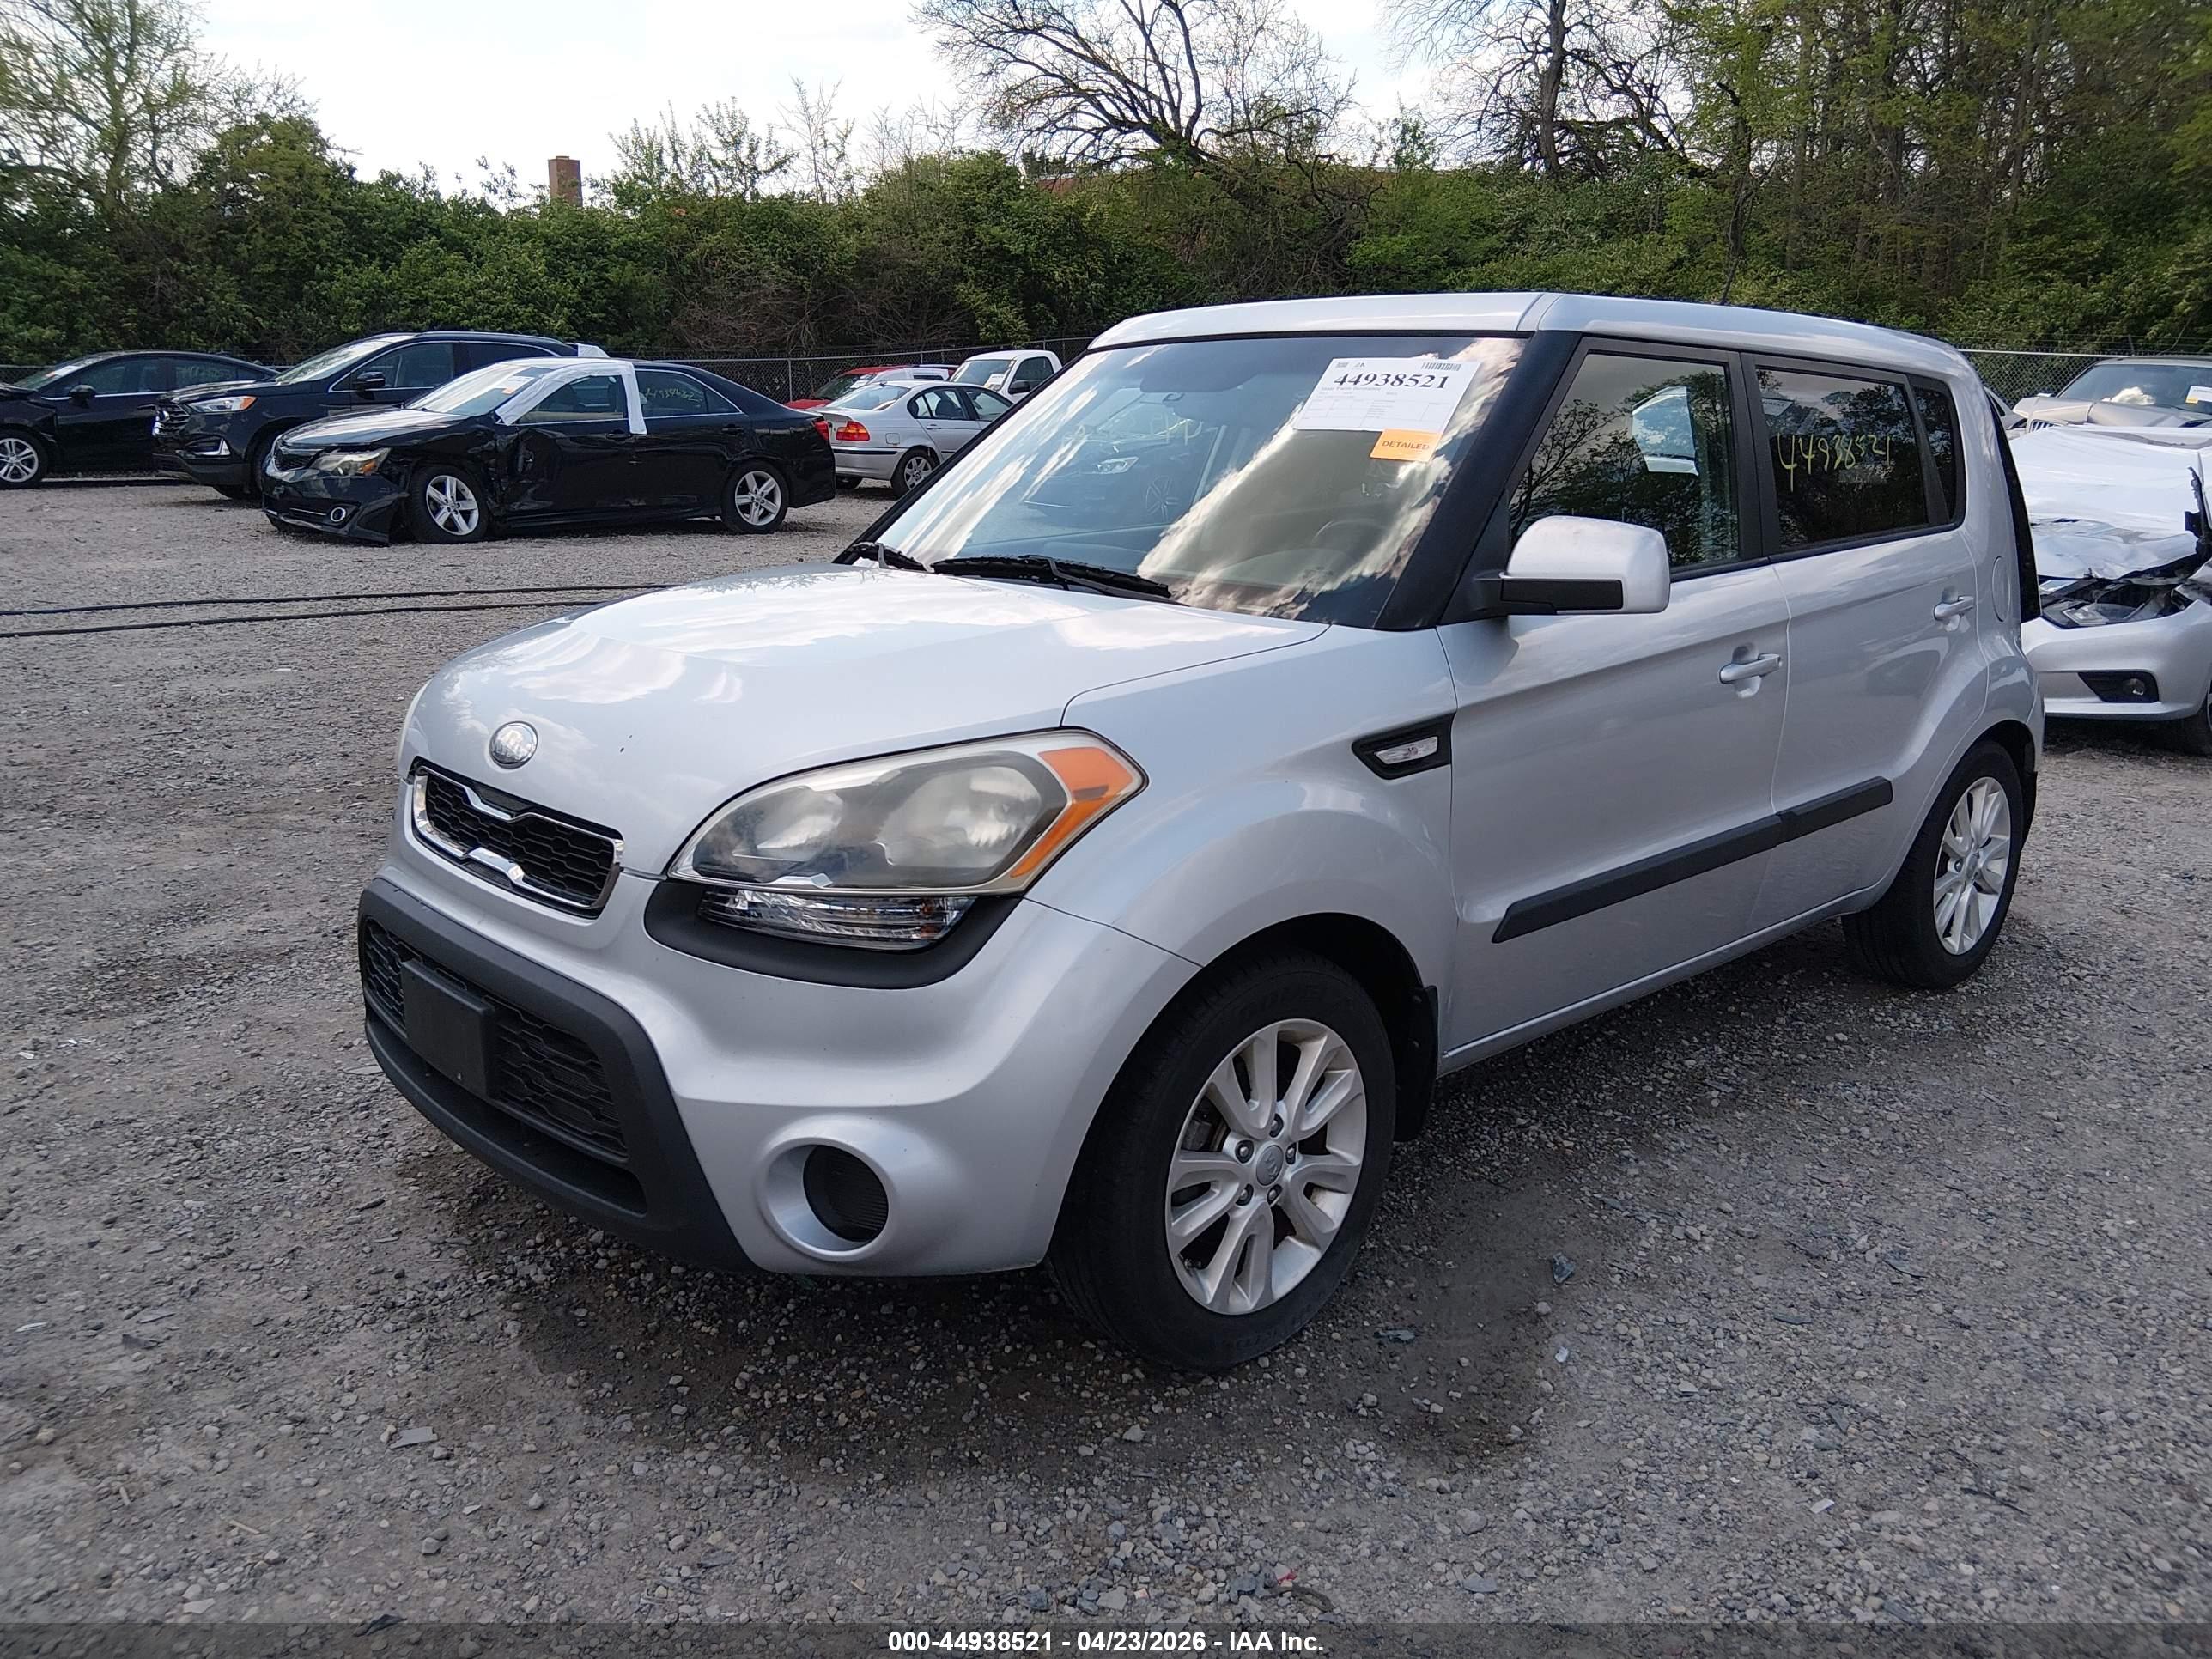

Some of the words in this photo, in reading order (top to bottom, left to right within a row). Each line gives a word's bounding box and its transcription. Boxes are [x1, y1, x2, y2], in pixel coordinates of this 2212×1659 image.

[1334, 372, 1450, 389] 44938521
[1381, 440, 1431, 452] DETAILED
[1777, 432, 1891, 492] 44938521
